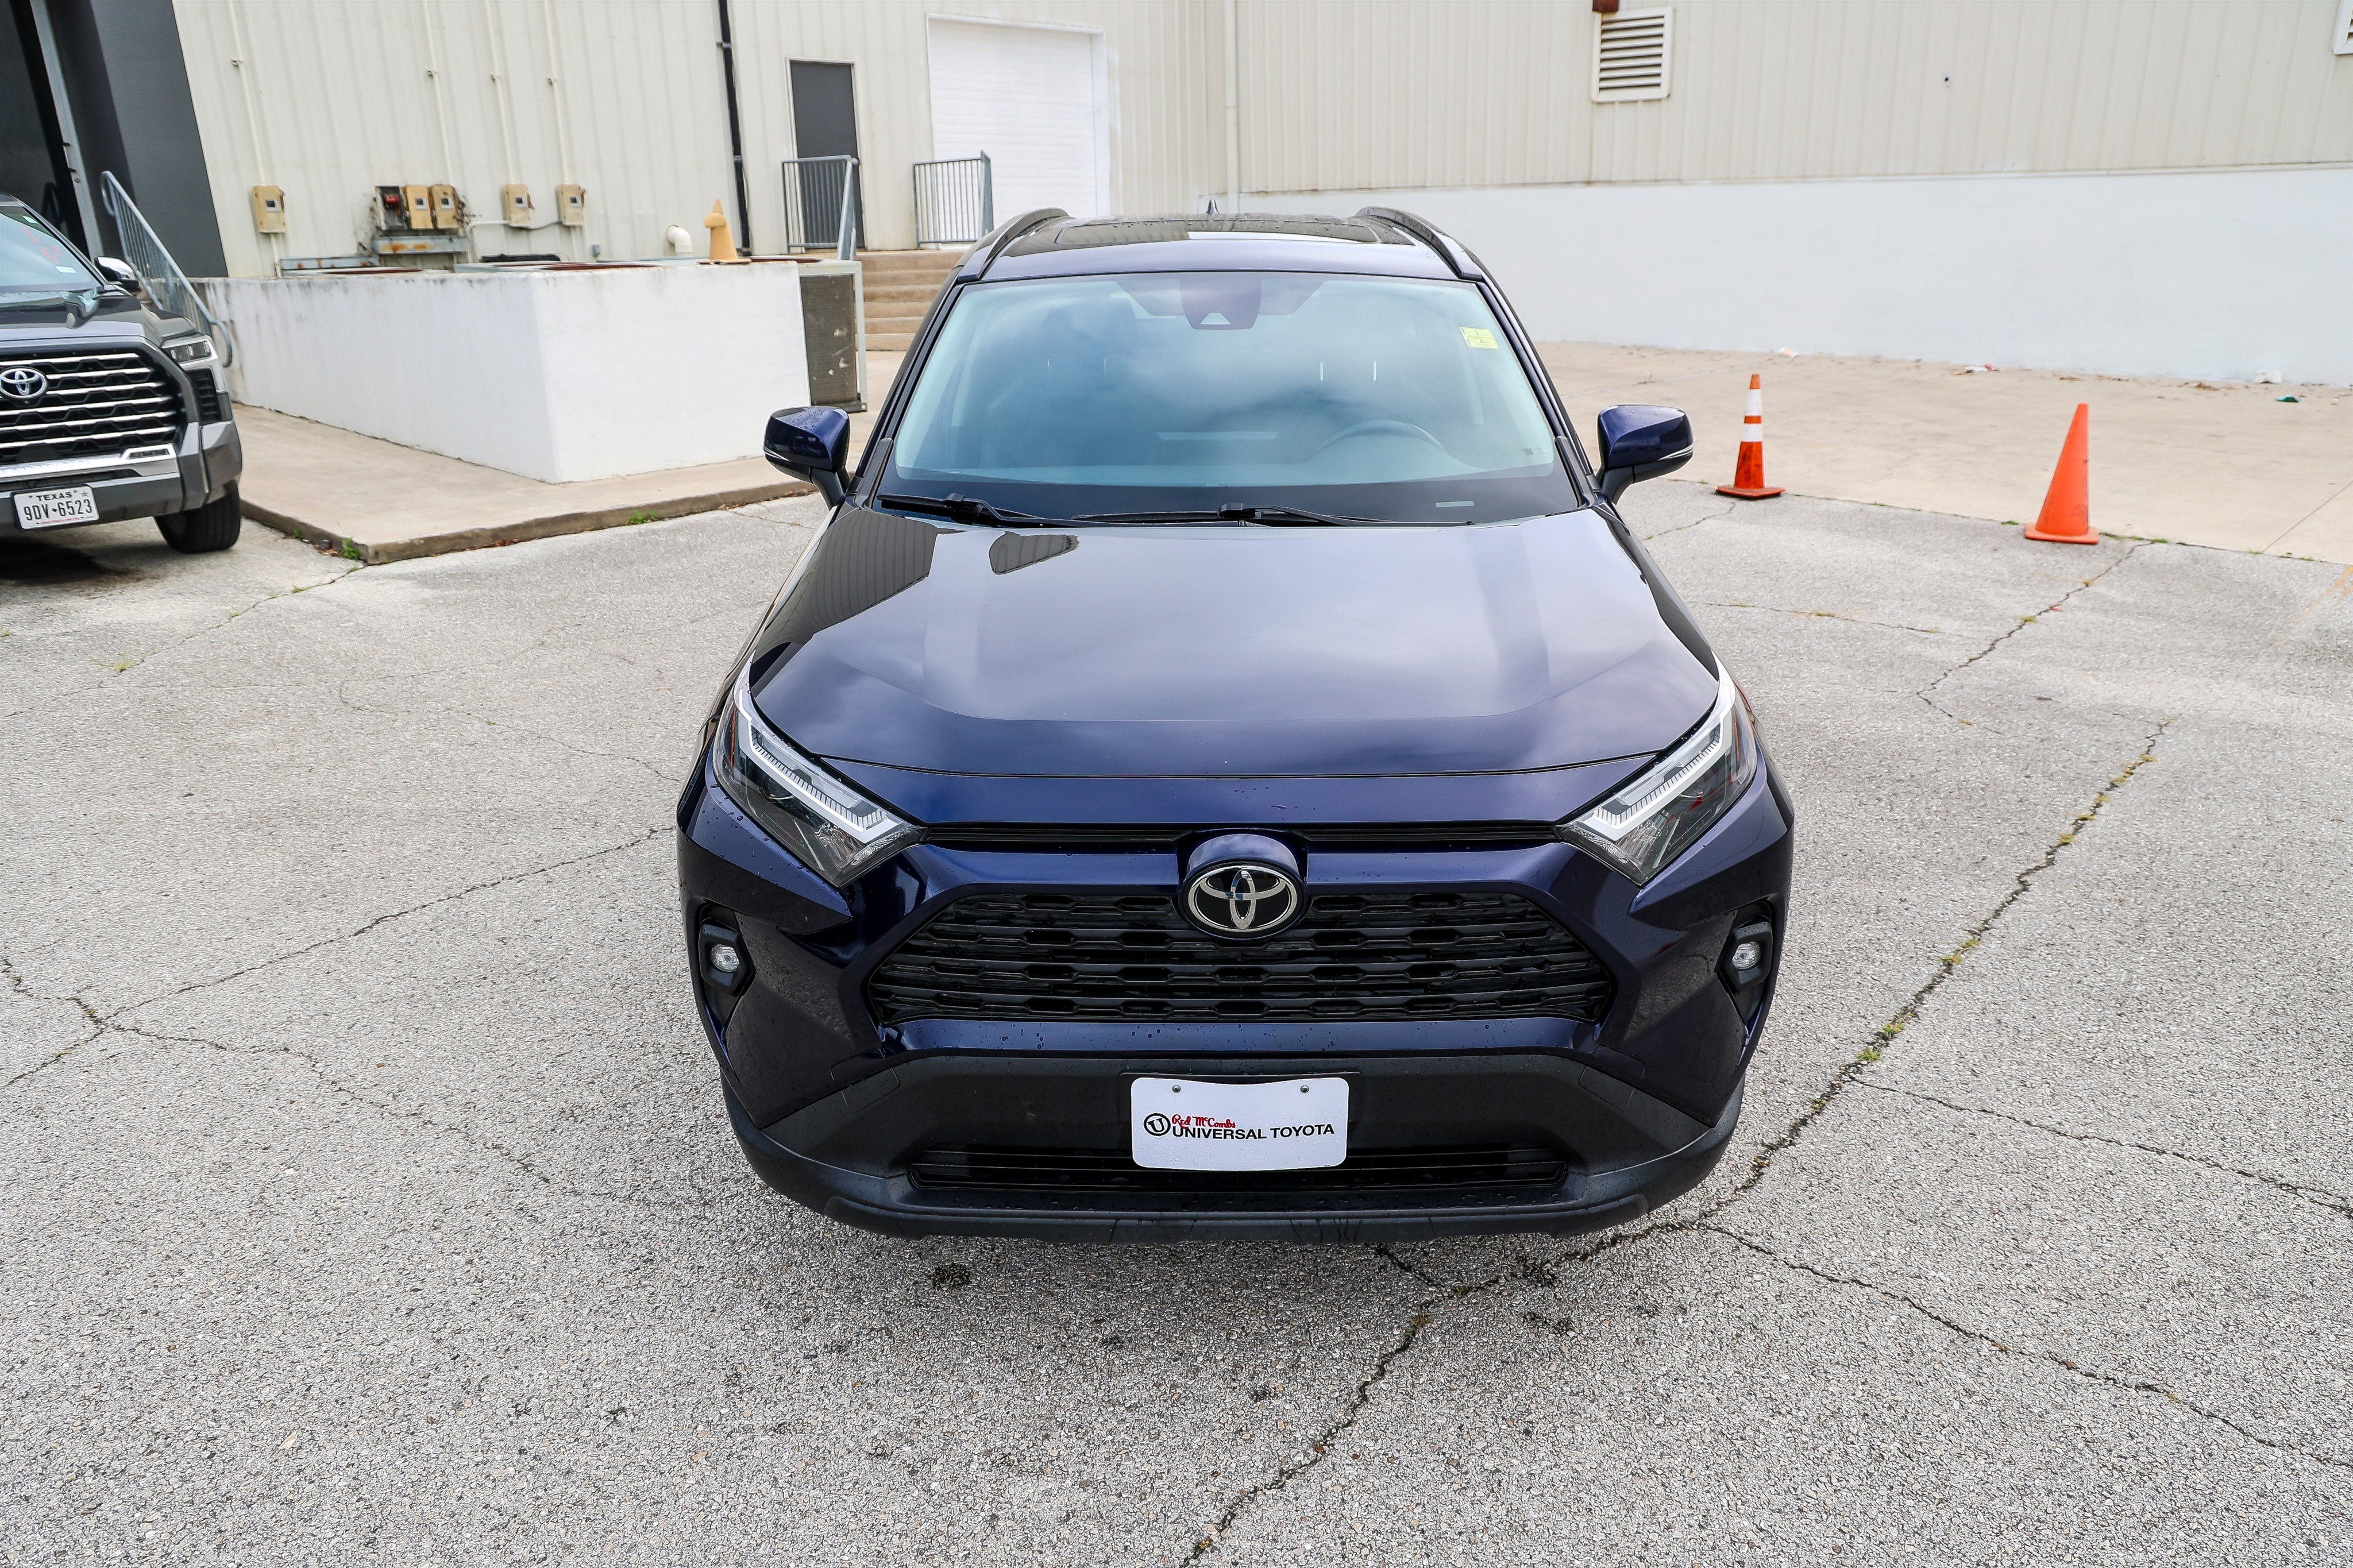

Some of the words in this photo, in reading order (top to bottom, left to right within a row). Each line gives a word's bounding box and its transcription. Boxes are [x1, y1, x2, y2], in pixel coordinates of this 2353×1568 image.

[36, 492, 72, 501] TEXAS
[1171, 1114, 1191, 1129] Red
[1192, 1115, 1236, 1129] McCombs
[1172, 1126, 1267, 1140] UNIVERSAL
[1270, 1123, 1335, 1138] TOYOTA
